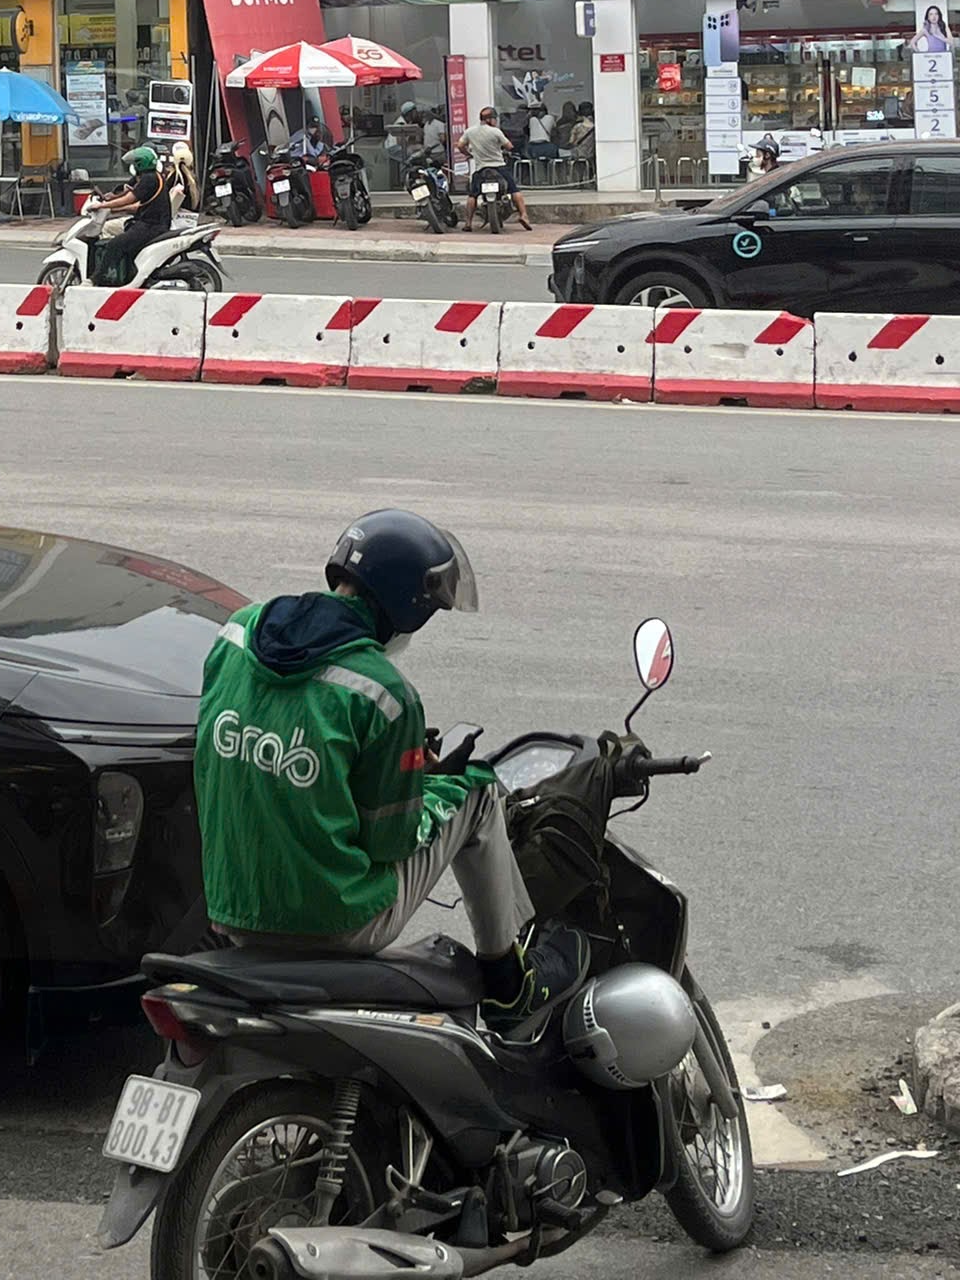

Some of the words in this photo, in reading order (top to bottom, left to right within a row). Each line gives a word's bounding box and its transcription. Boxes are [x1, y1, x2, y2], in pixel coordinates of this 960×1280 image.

[357, 49, 383, 61] 5G
[928, 59, 938, 73] 2
[929, 89, 939, 103] 5
[931, 118, 940, 131] 2
[212, 709, 320, 788] Grab
[109, 1120, 179, 1164] 800.43
